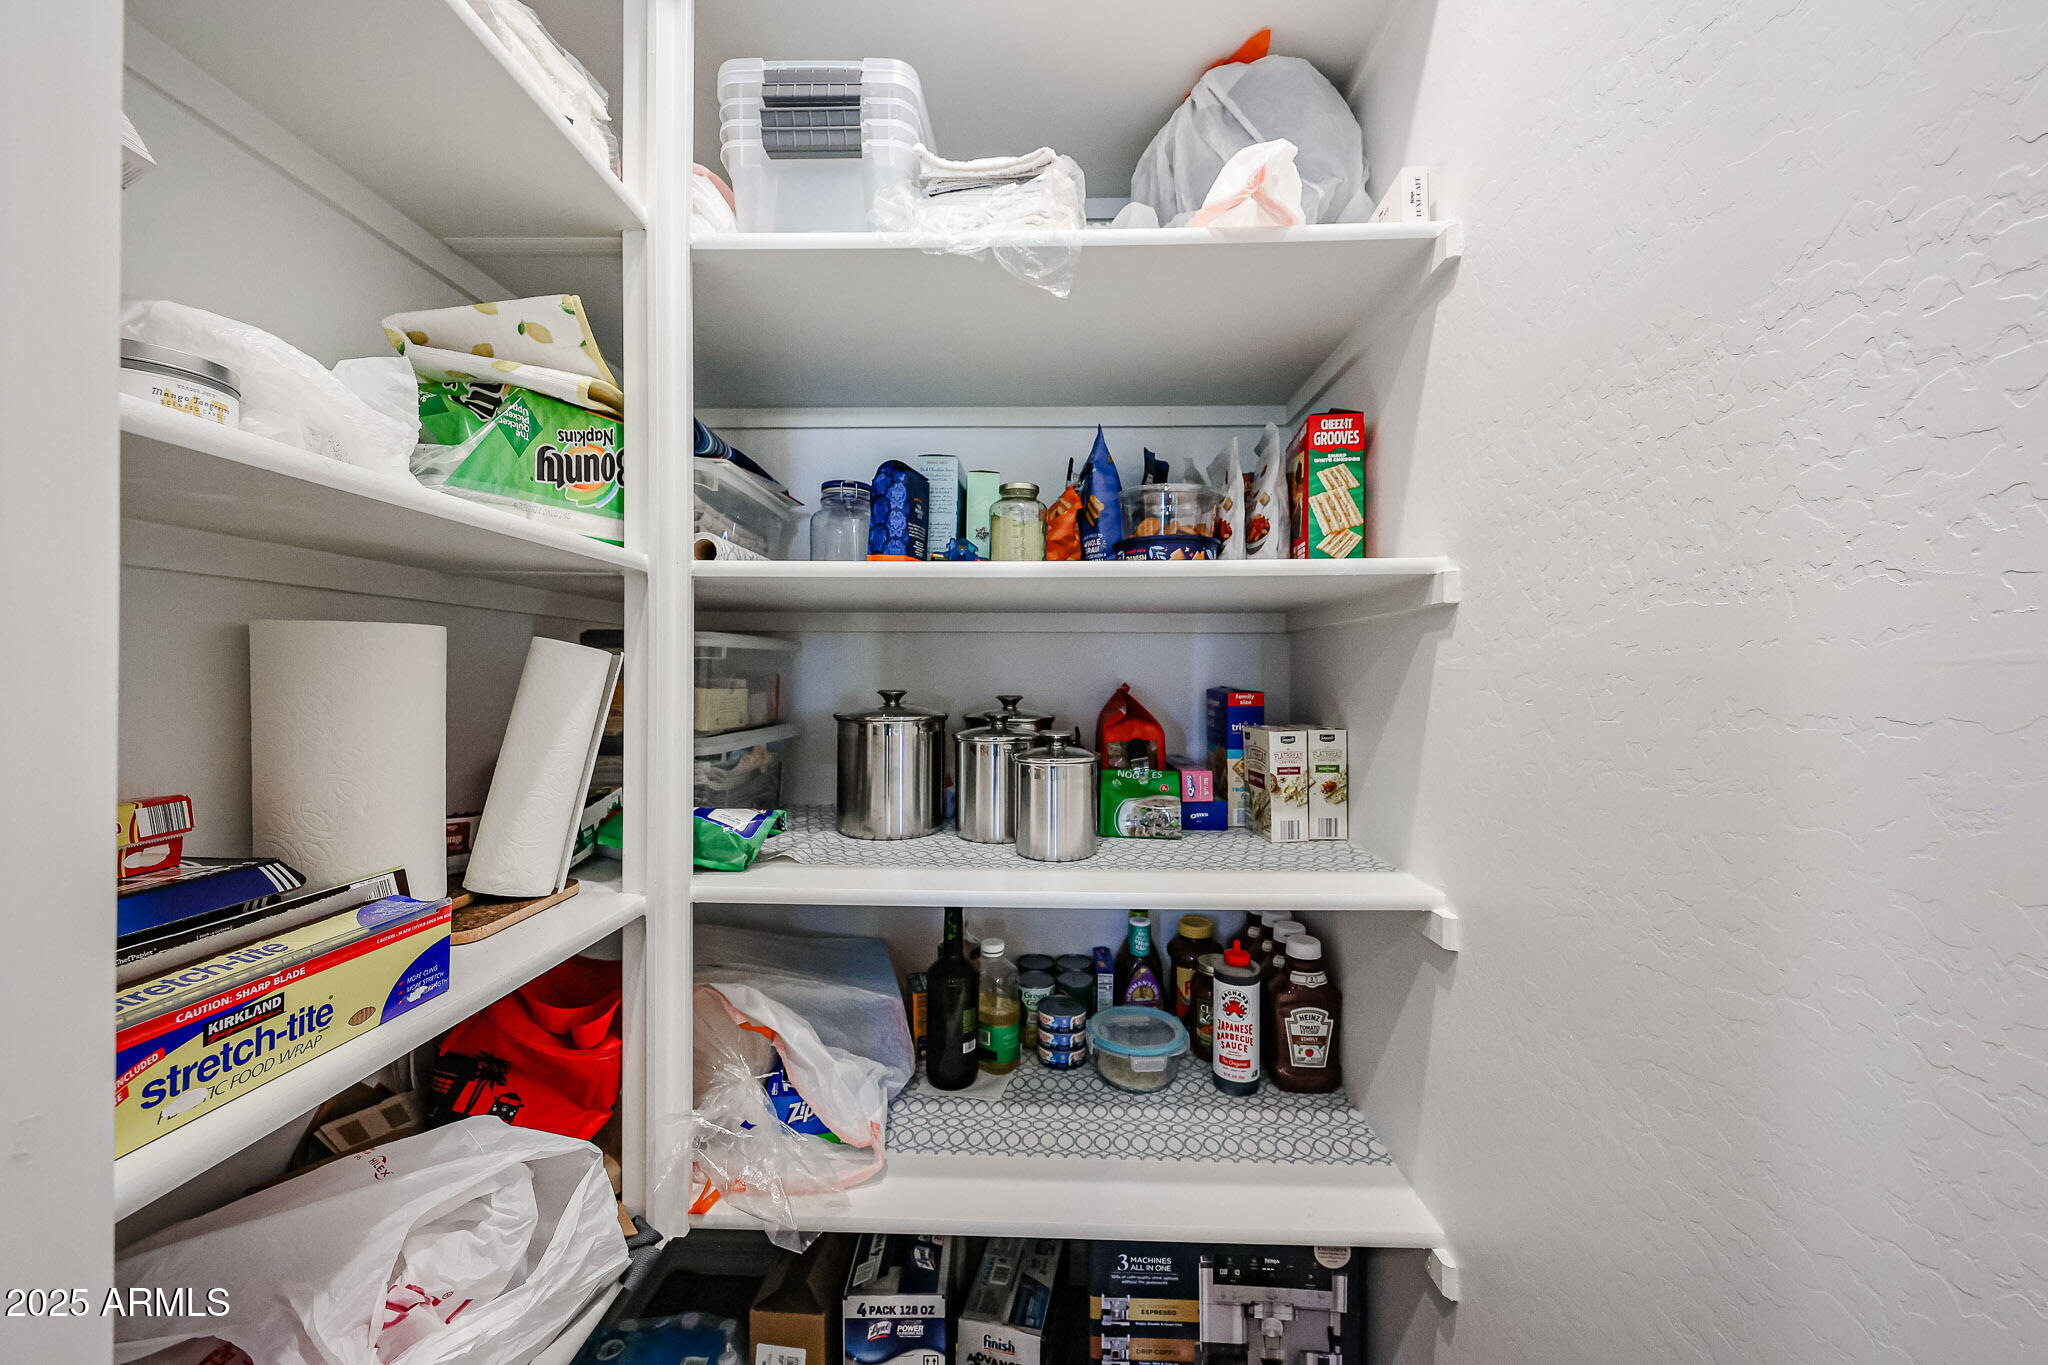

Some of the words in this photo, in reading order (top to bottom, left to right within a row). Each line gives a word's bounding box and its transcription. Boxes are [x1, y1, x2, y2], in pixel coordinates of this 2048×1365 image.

[152, 387, 190, 402] Mango
[499, 417, 530, 432] Quicker
[515, 429, 530, 441] The
[557, 427, 615, 447] Napkins
[1313, 430, 1360, 446] GROOVES
[1117, 769, 1162, 780] NOOES
[406, 974, 422, 984] MORE
[423, 964, 438, 976] CLING
[422, 971, 445, 985] STRETCH
[175, 995, 233, 1024] CAUTION:
[235, 980, 271, 1001] SHARP
[273, 966, 306, 986] BLADE
[207, 996, 282, 1036] KIRKLAND
[1298, 1014, 1321, 1022] HEINZ
[1217, 1018, 1253, 1035] JAPANESE
[1216, 1032, 1254, 1047] BARBECUE
[1220, 1041, 1248, 1053] SAUCE
[140, 1003, 334, 1110] stretch-tite
[230, 1057, 275, 1089] FOOD
[278, 1034, 323, 1065] WRAP
[787, 1101, 814, 1123] Zip
[368, 1157, 390, 1178] HILEX
[1117, 1254, 1129, 1271] 3
[1130, 1256, 1172, 1264] MACHINES
[856, 1302, 867, 1317] 4
[869, 1305, 897, 1315] PACK
[900, 1305, 918, 1315] 128
[921, 1305, 935, 1315] OZ
[983, 1334, 1015, 1352] finish
[966, 1352, 1022, 1365] ADVAN
